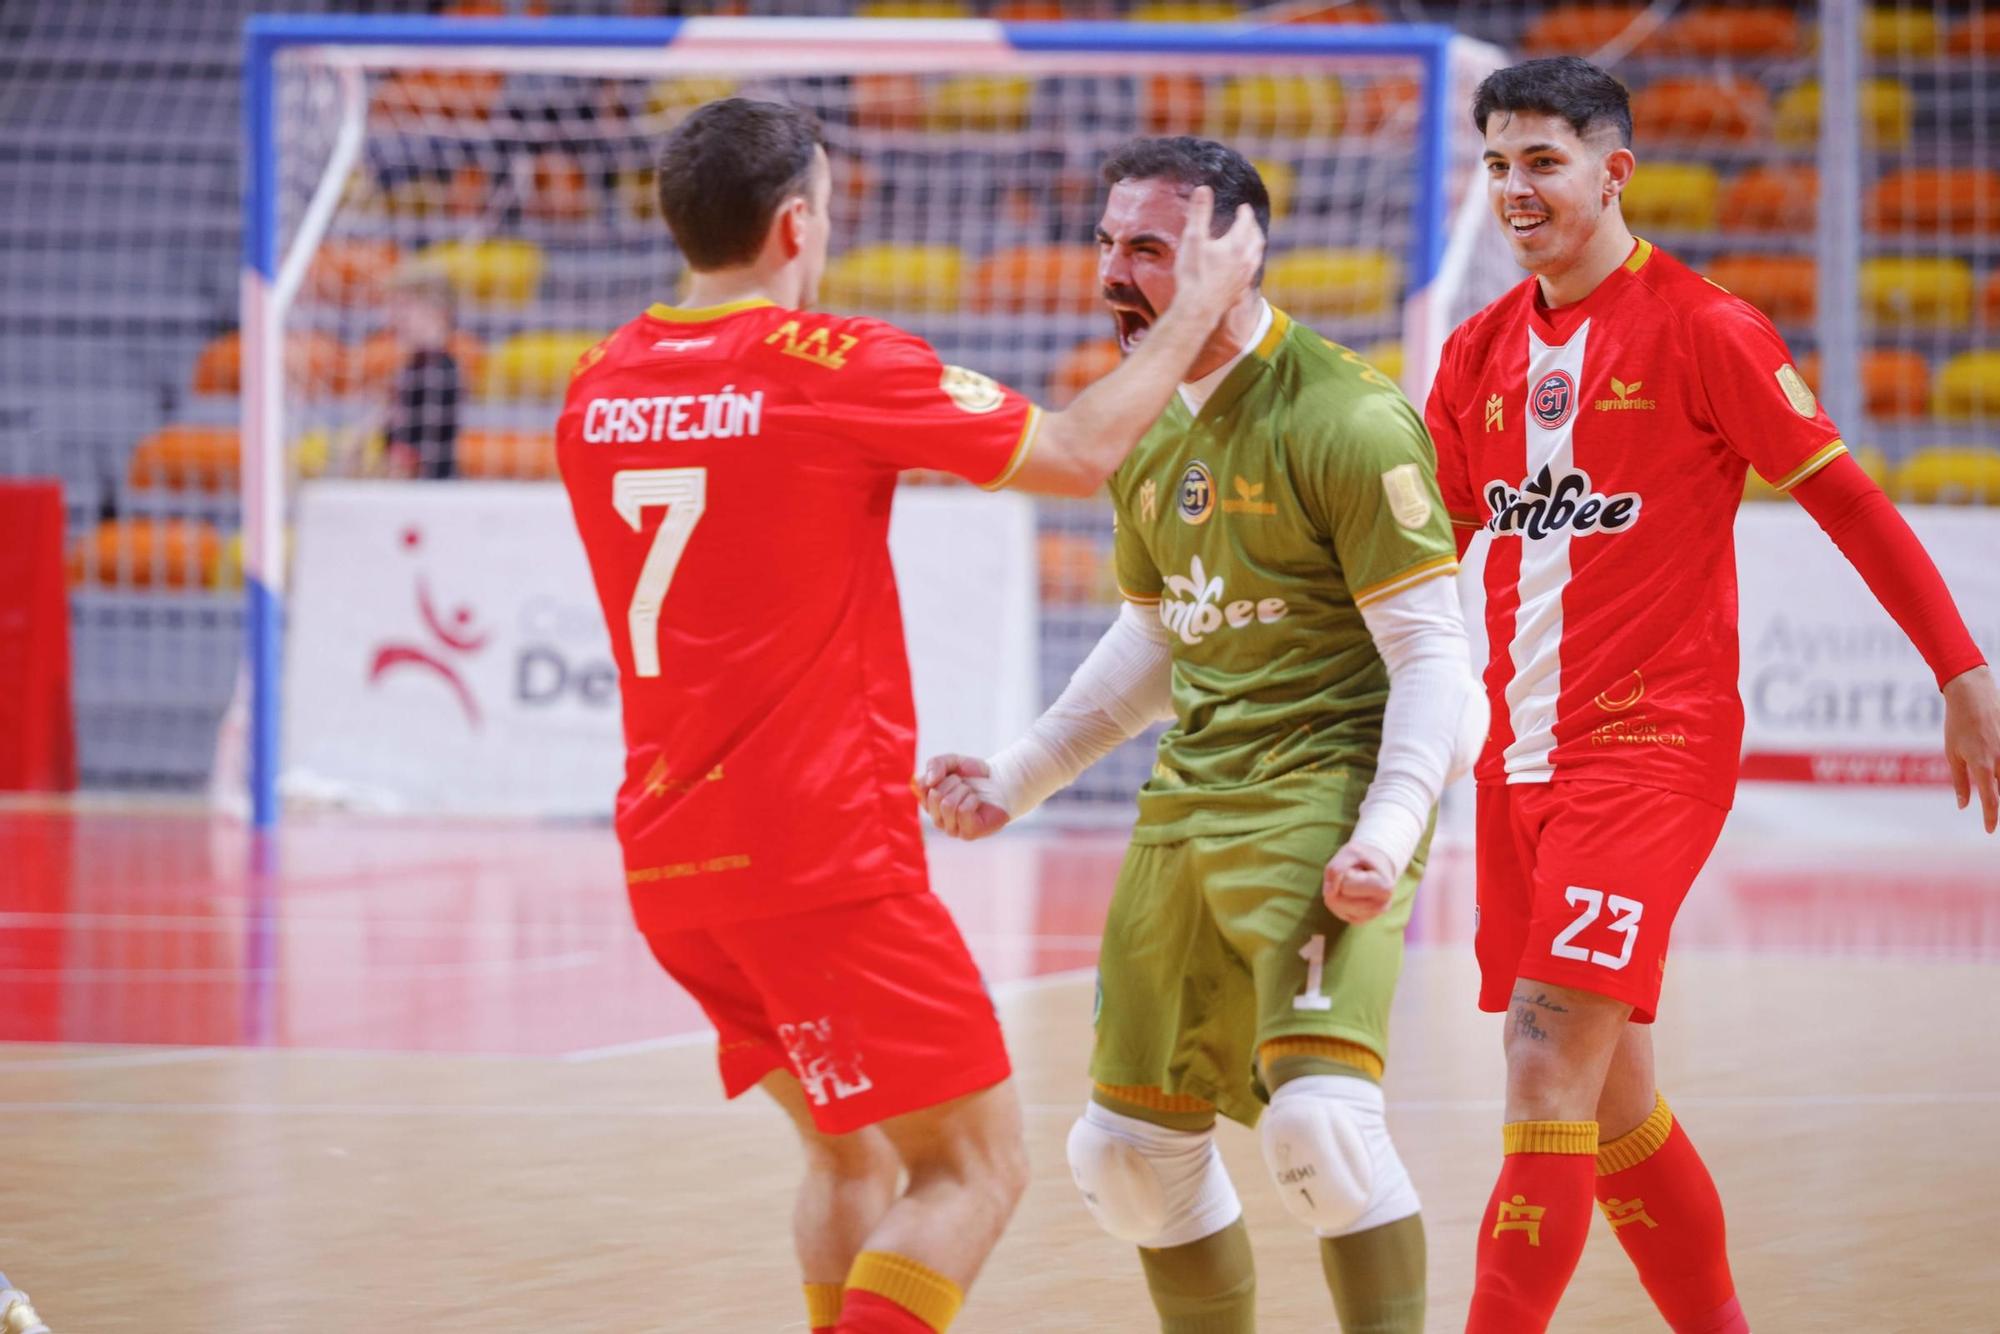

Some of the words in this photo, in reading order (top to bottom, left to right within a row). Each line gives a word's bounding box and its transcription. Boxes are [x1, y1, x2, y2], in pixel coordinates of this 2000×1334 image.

[582, 384, 764, 443] CASTEJÓN
[612, 467, 708, 678] 7
[1551, 885, 1643, 970] 23
[1293, 934, 1331, 1010] 1
